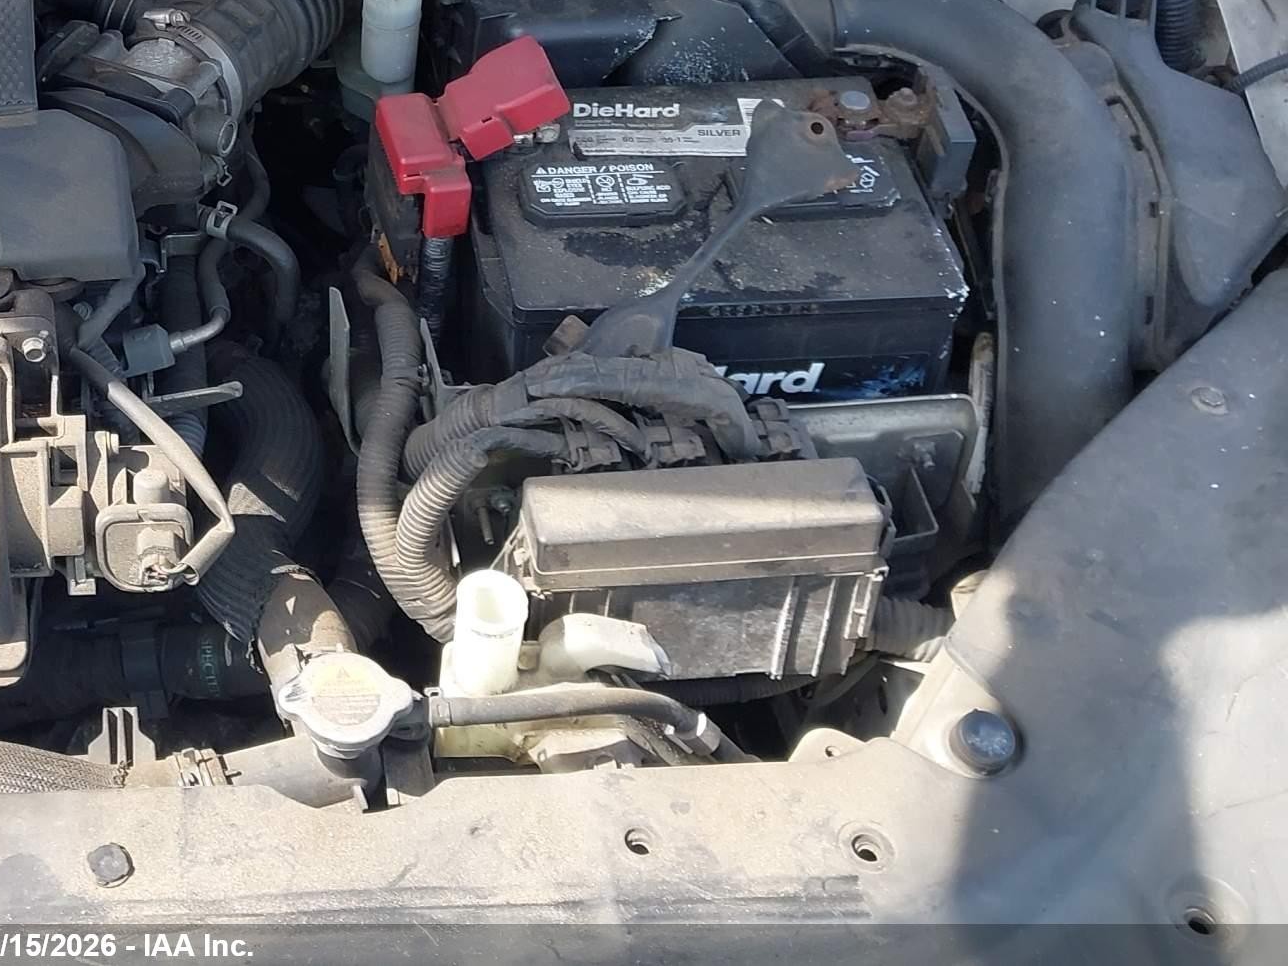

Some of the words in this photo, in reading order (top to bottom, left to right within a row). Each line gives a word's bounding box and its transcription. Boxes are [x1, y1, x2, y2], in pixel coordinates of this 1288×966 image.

[572, 102, 681, 118] DieHard
[697, 129, 741, 137] SILVER
[547, 166, 598, 174] DANGER
[609, 163, 655, 172] POISON
